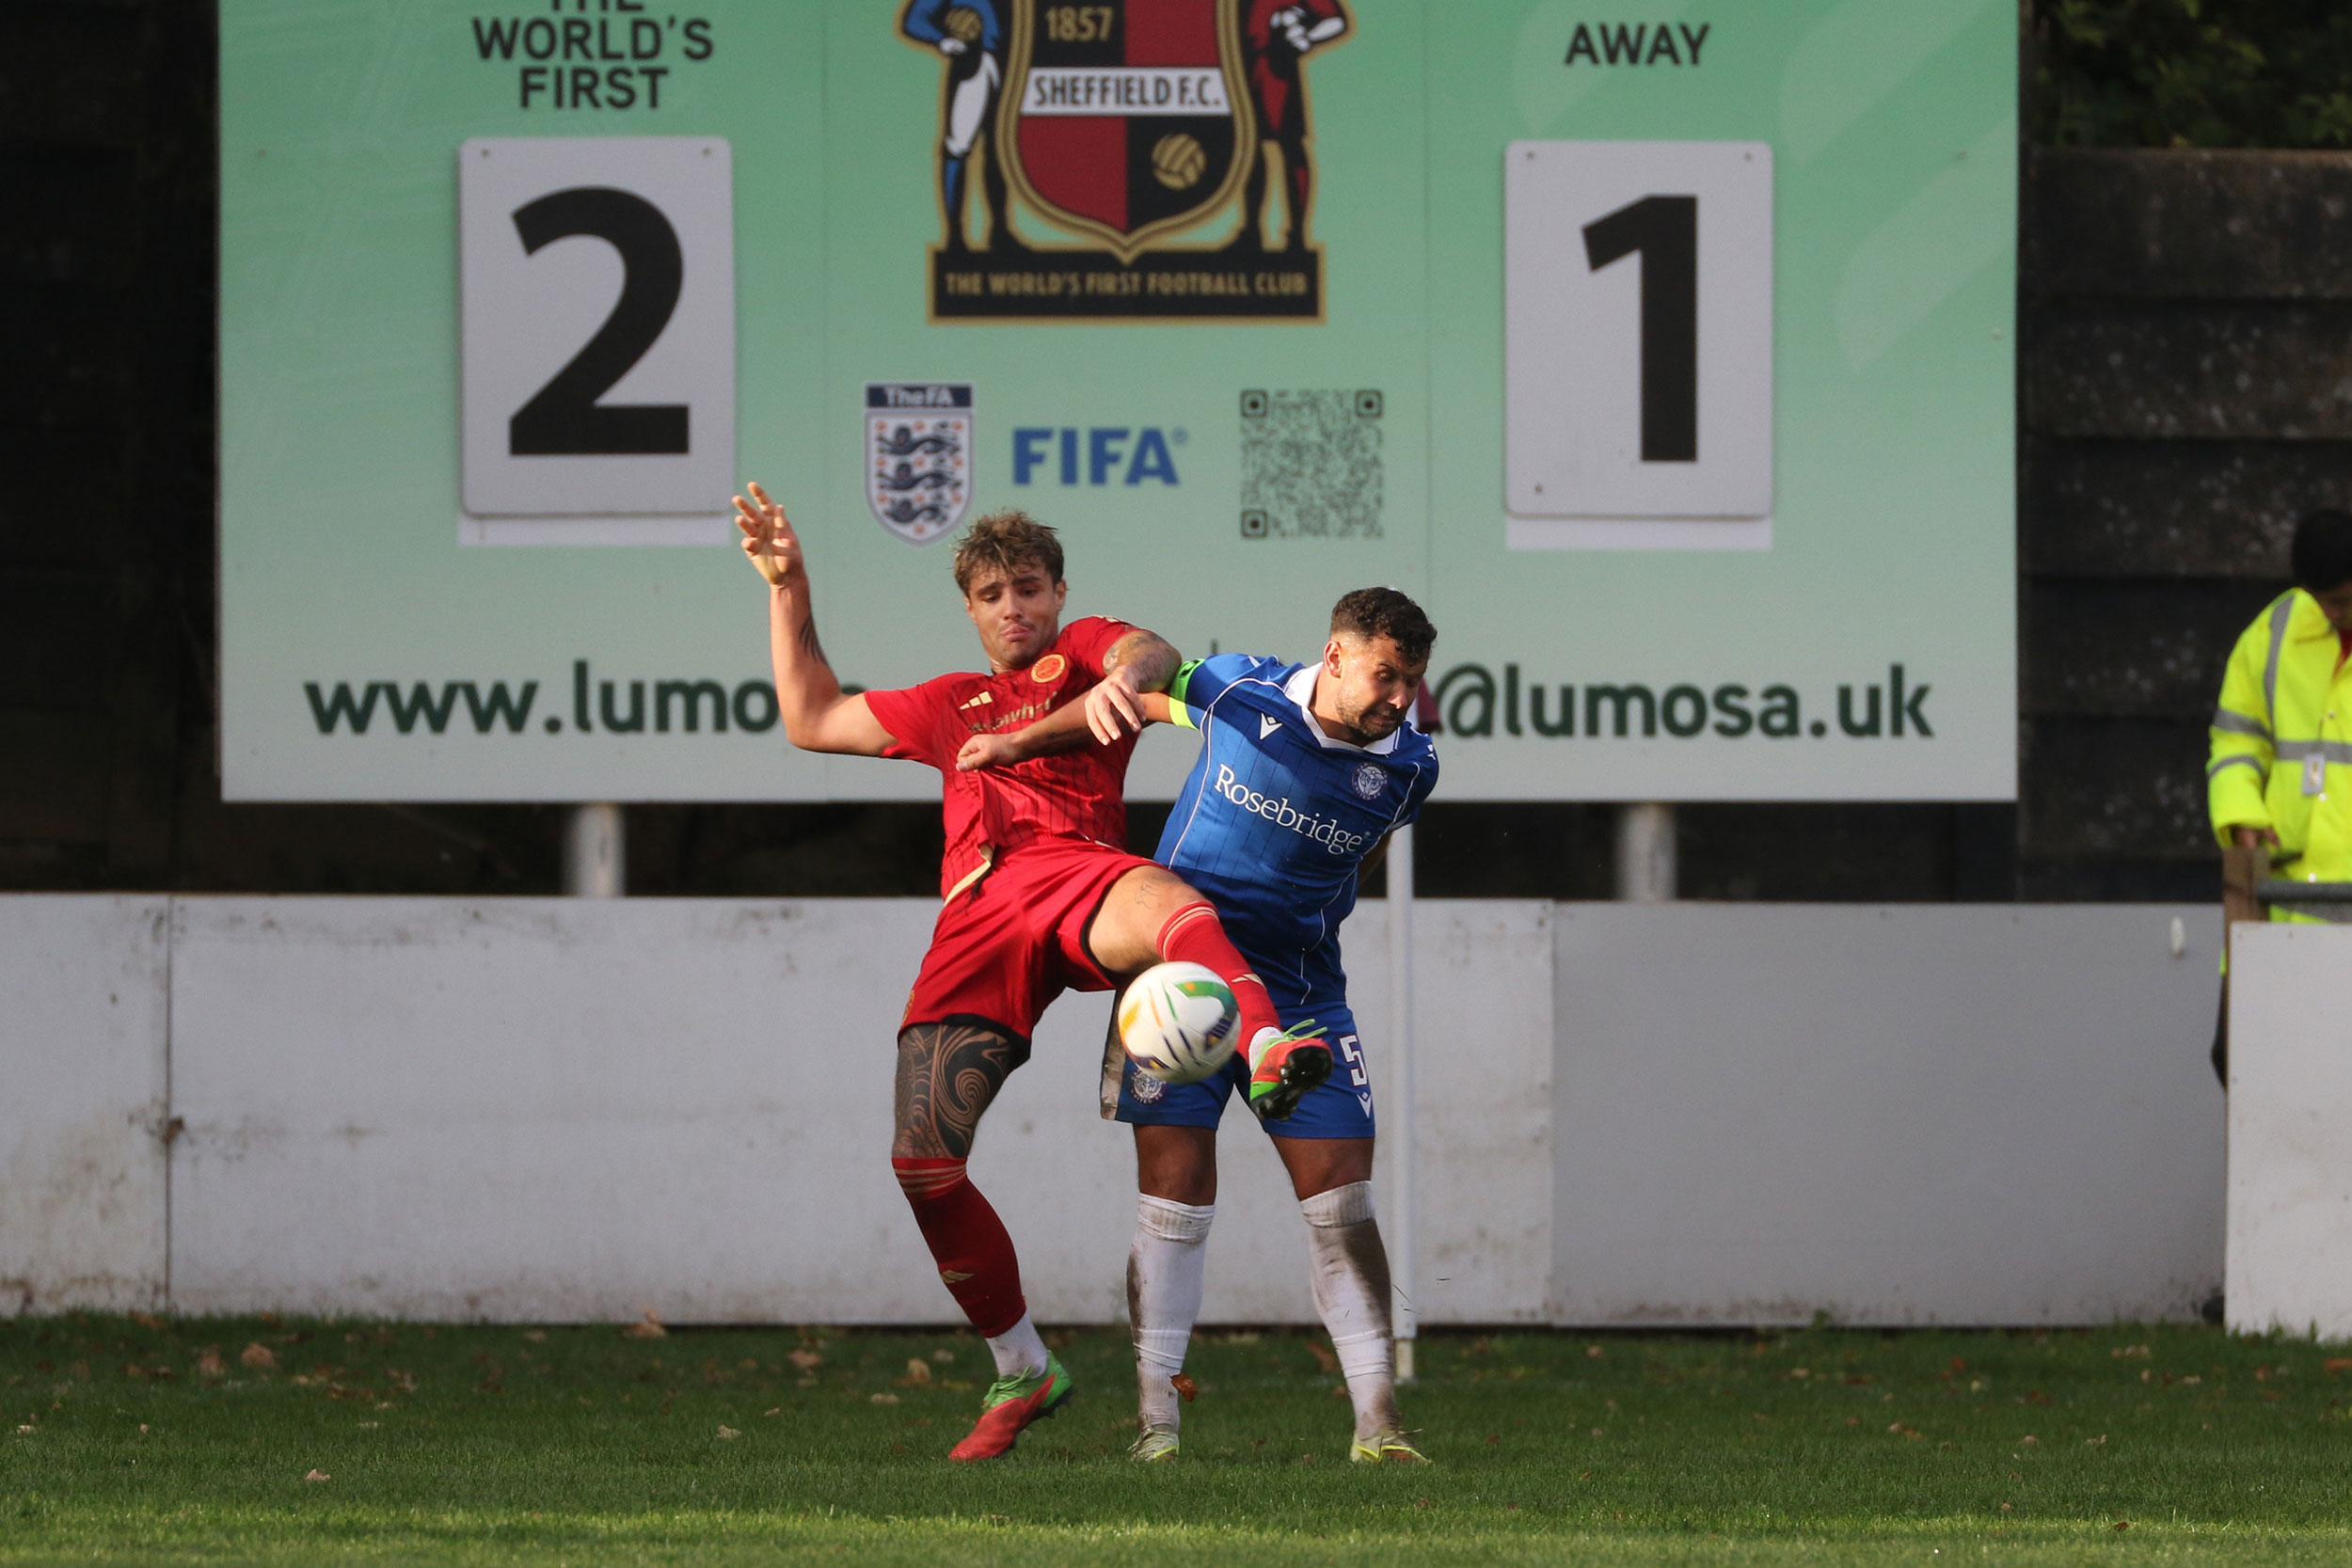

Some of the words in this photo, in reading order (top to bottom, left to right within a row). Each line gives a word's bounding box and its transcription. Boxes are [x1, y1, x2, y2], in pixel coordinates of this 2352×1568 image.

[472, 17, 713, 60] WORLD'S
[1046, 6, 1113, 41] 1857
[1565, 24, 1710, 65] AWAY
[520, 67, 669, 109] FIRST
[1035, 75, 1170, 106] SHEFFIELD
[1178, 75, 1221, 106] F.C.
[946, 272, 983, 295] THE
[988, 272, 1081, 296] WORLD'S
[1085, 272, 1142, 295] FIRST
[1146, 272, 1250, 295] FOOTBALL
[1254, 272, 1307, 295] CLUB
[509, 185, 690, 455] 2
[1582, 195, 1698, 463] 1
[304, 659, 867, 735] www.lumo
[1434, 663, 1934, 738] @lumosa.uk
[1214, 763, 1363, 855] Rosebridge
[1339, 1034, 1368, 1087] 5
